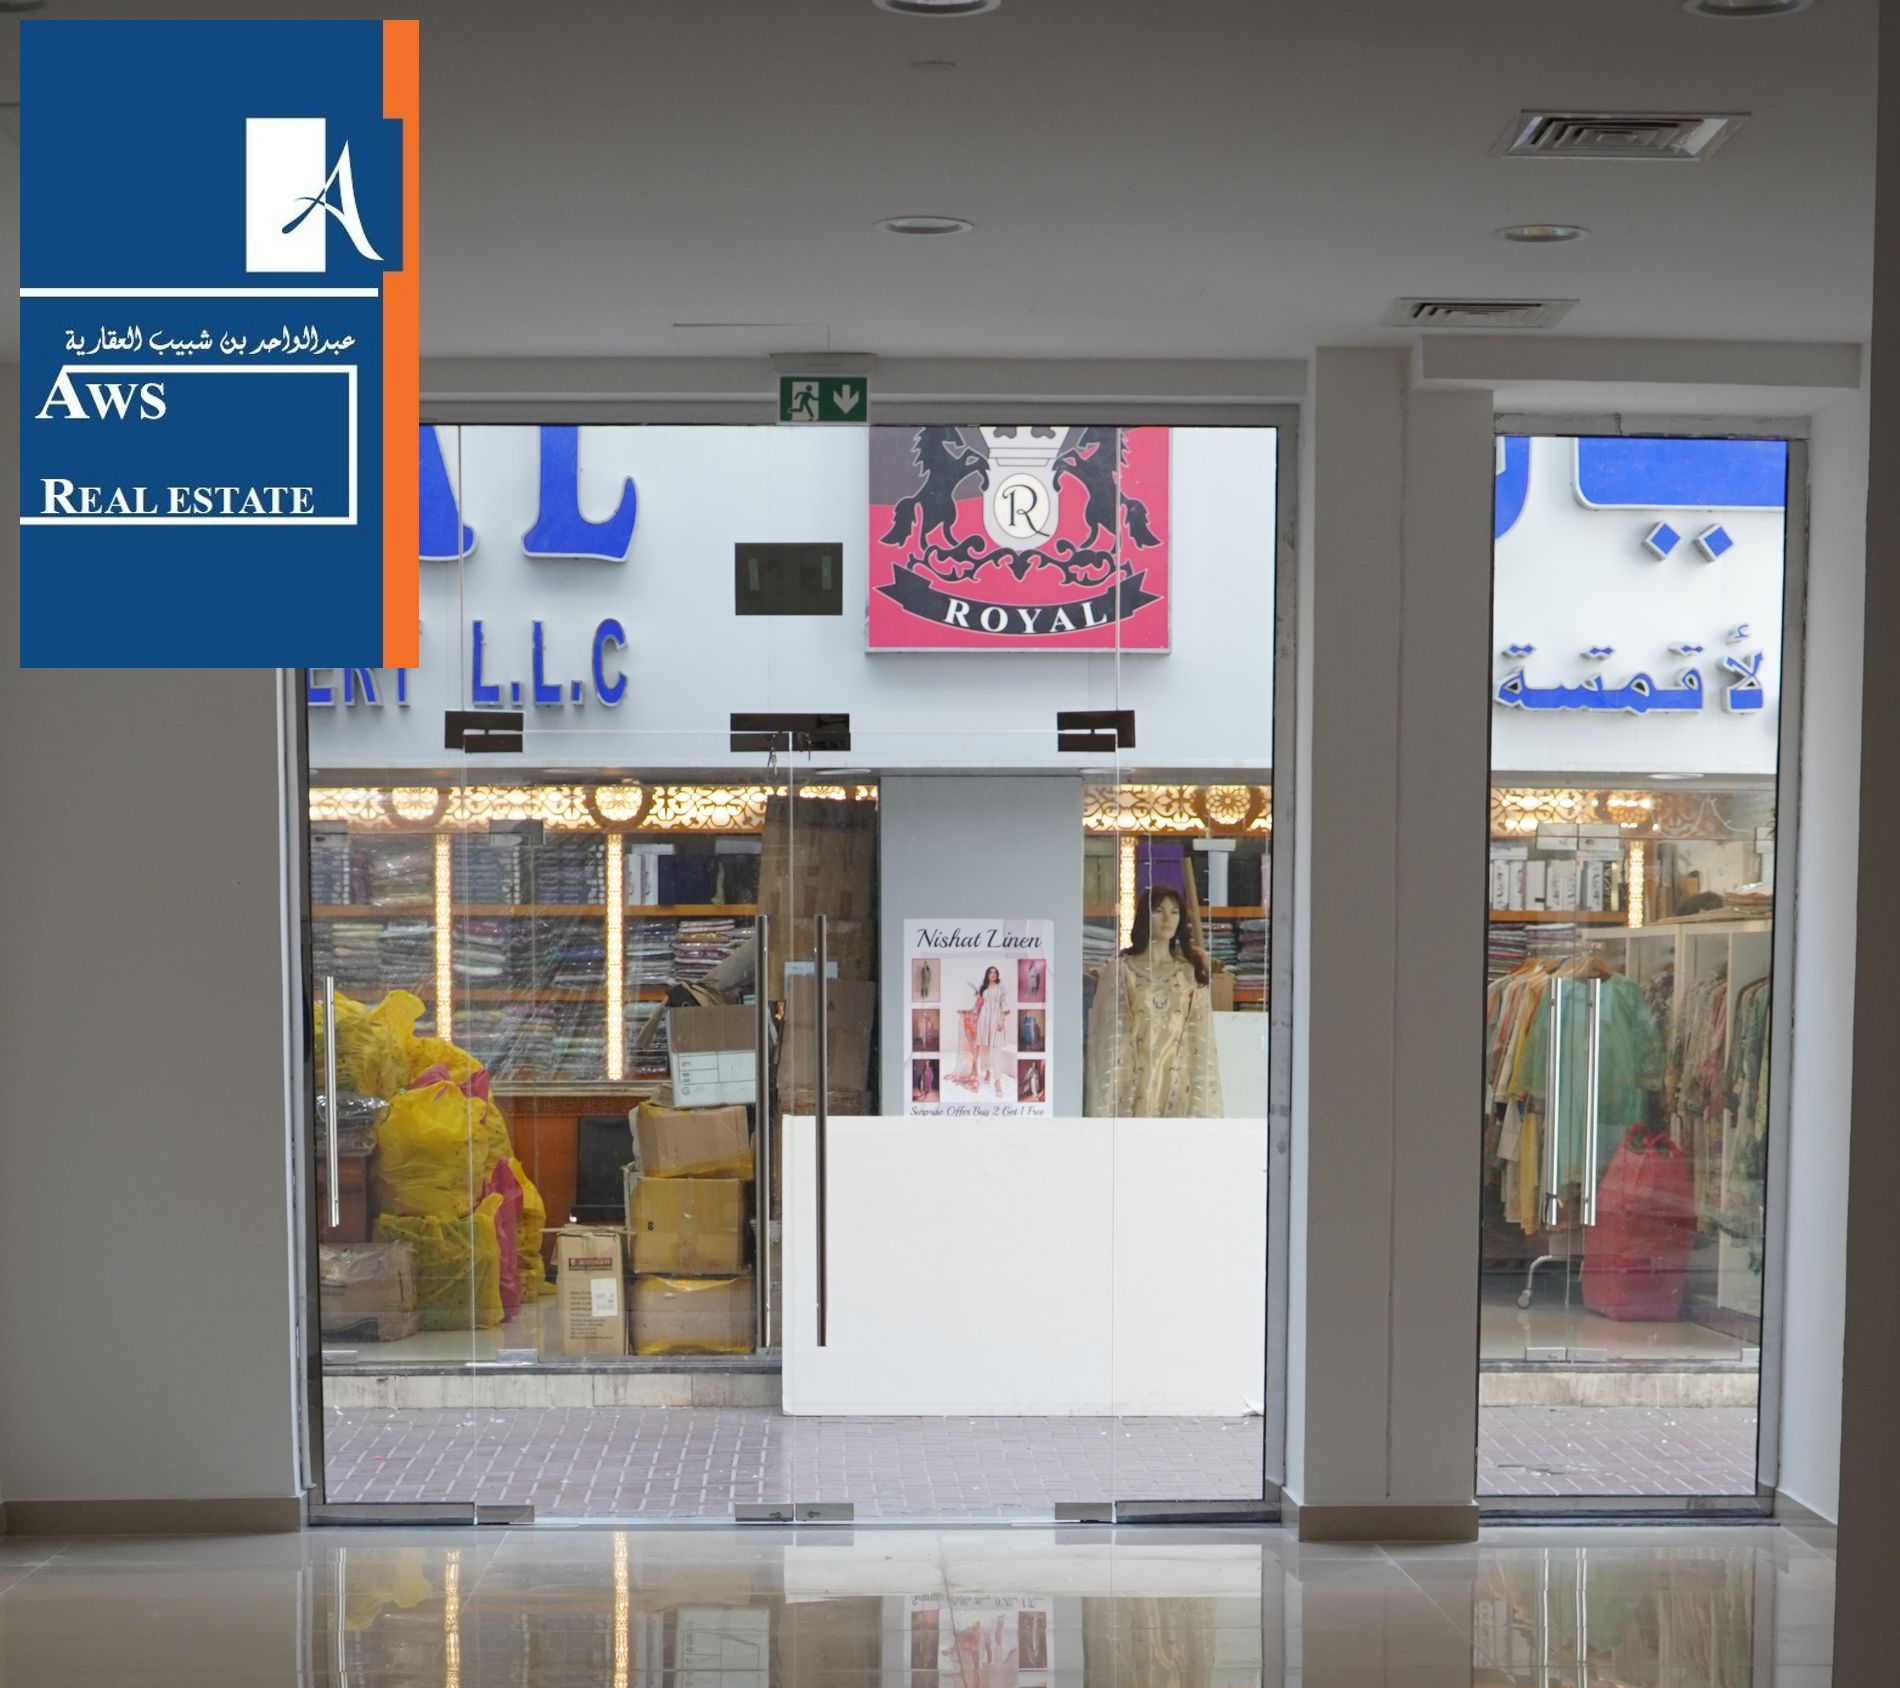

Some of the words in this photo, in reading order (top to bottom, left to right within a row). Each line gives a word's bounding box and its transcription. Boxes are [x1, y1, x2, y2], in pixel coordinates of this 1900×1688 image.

[1001, 484, 1051, 538] R
[942, 598, 1108, 634] ROYAL
[916, 928, 981, 949] Nishat
[987, 929, 1042, 949] Linen
[946, 1105, 971, 1117] Offer
[992, 1105, 1000, 1116] 2
